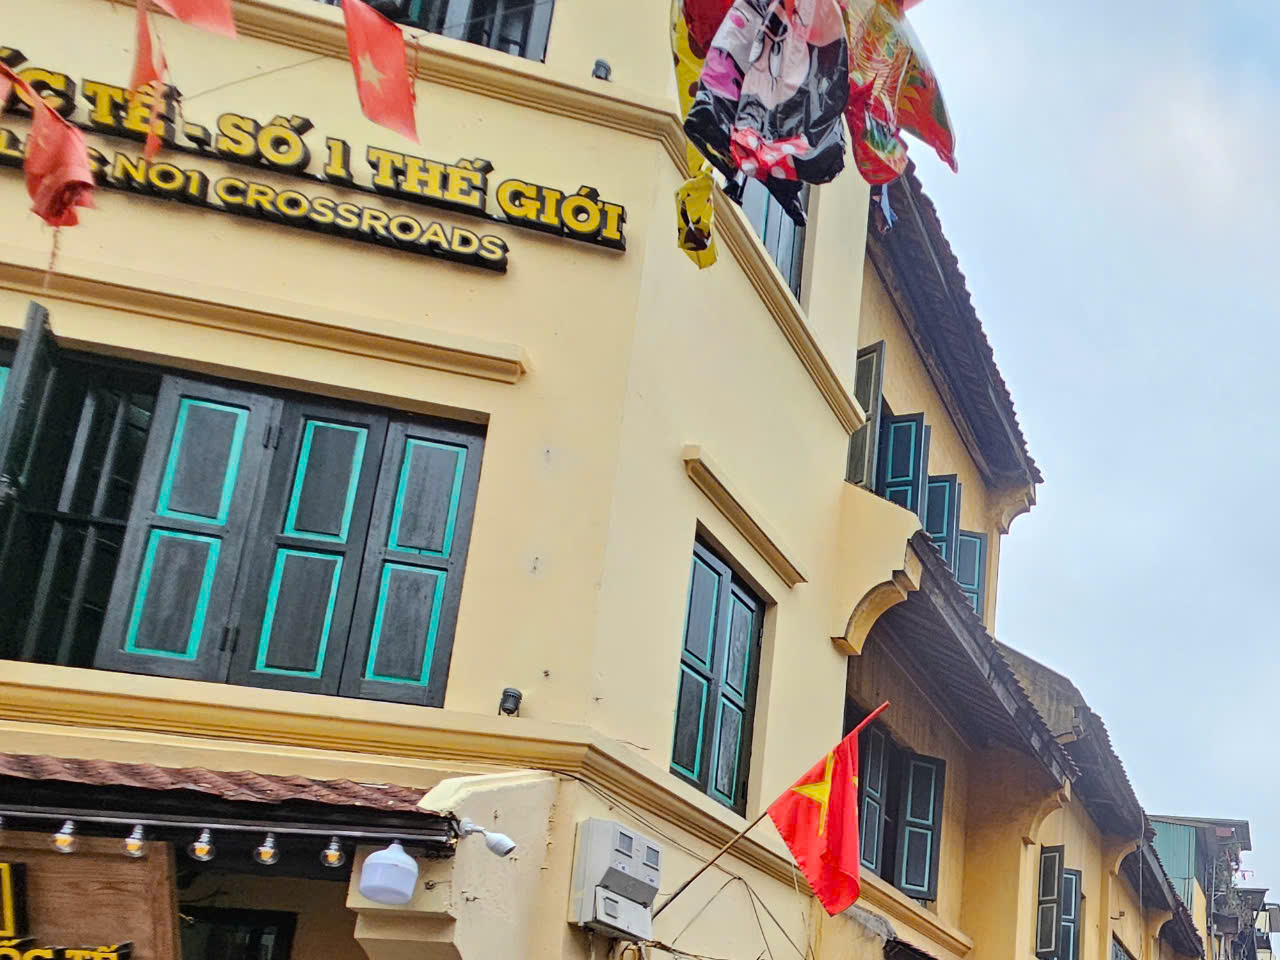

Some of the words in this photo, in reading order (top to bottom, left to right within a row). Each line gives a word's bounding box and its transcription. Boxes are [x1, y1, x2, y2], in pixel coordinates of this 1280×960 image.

[214, 177, 506, 261] CROSSROADS
[216, 112, 306, 167] SỐ
[326, 136, 348, 179] 1
[367, 145, 489, 206] THẾ
[496, 178, 625, 240] GIỚI
